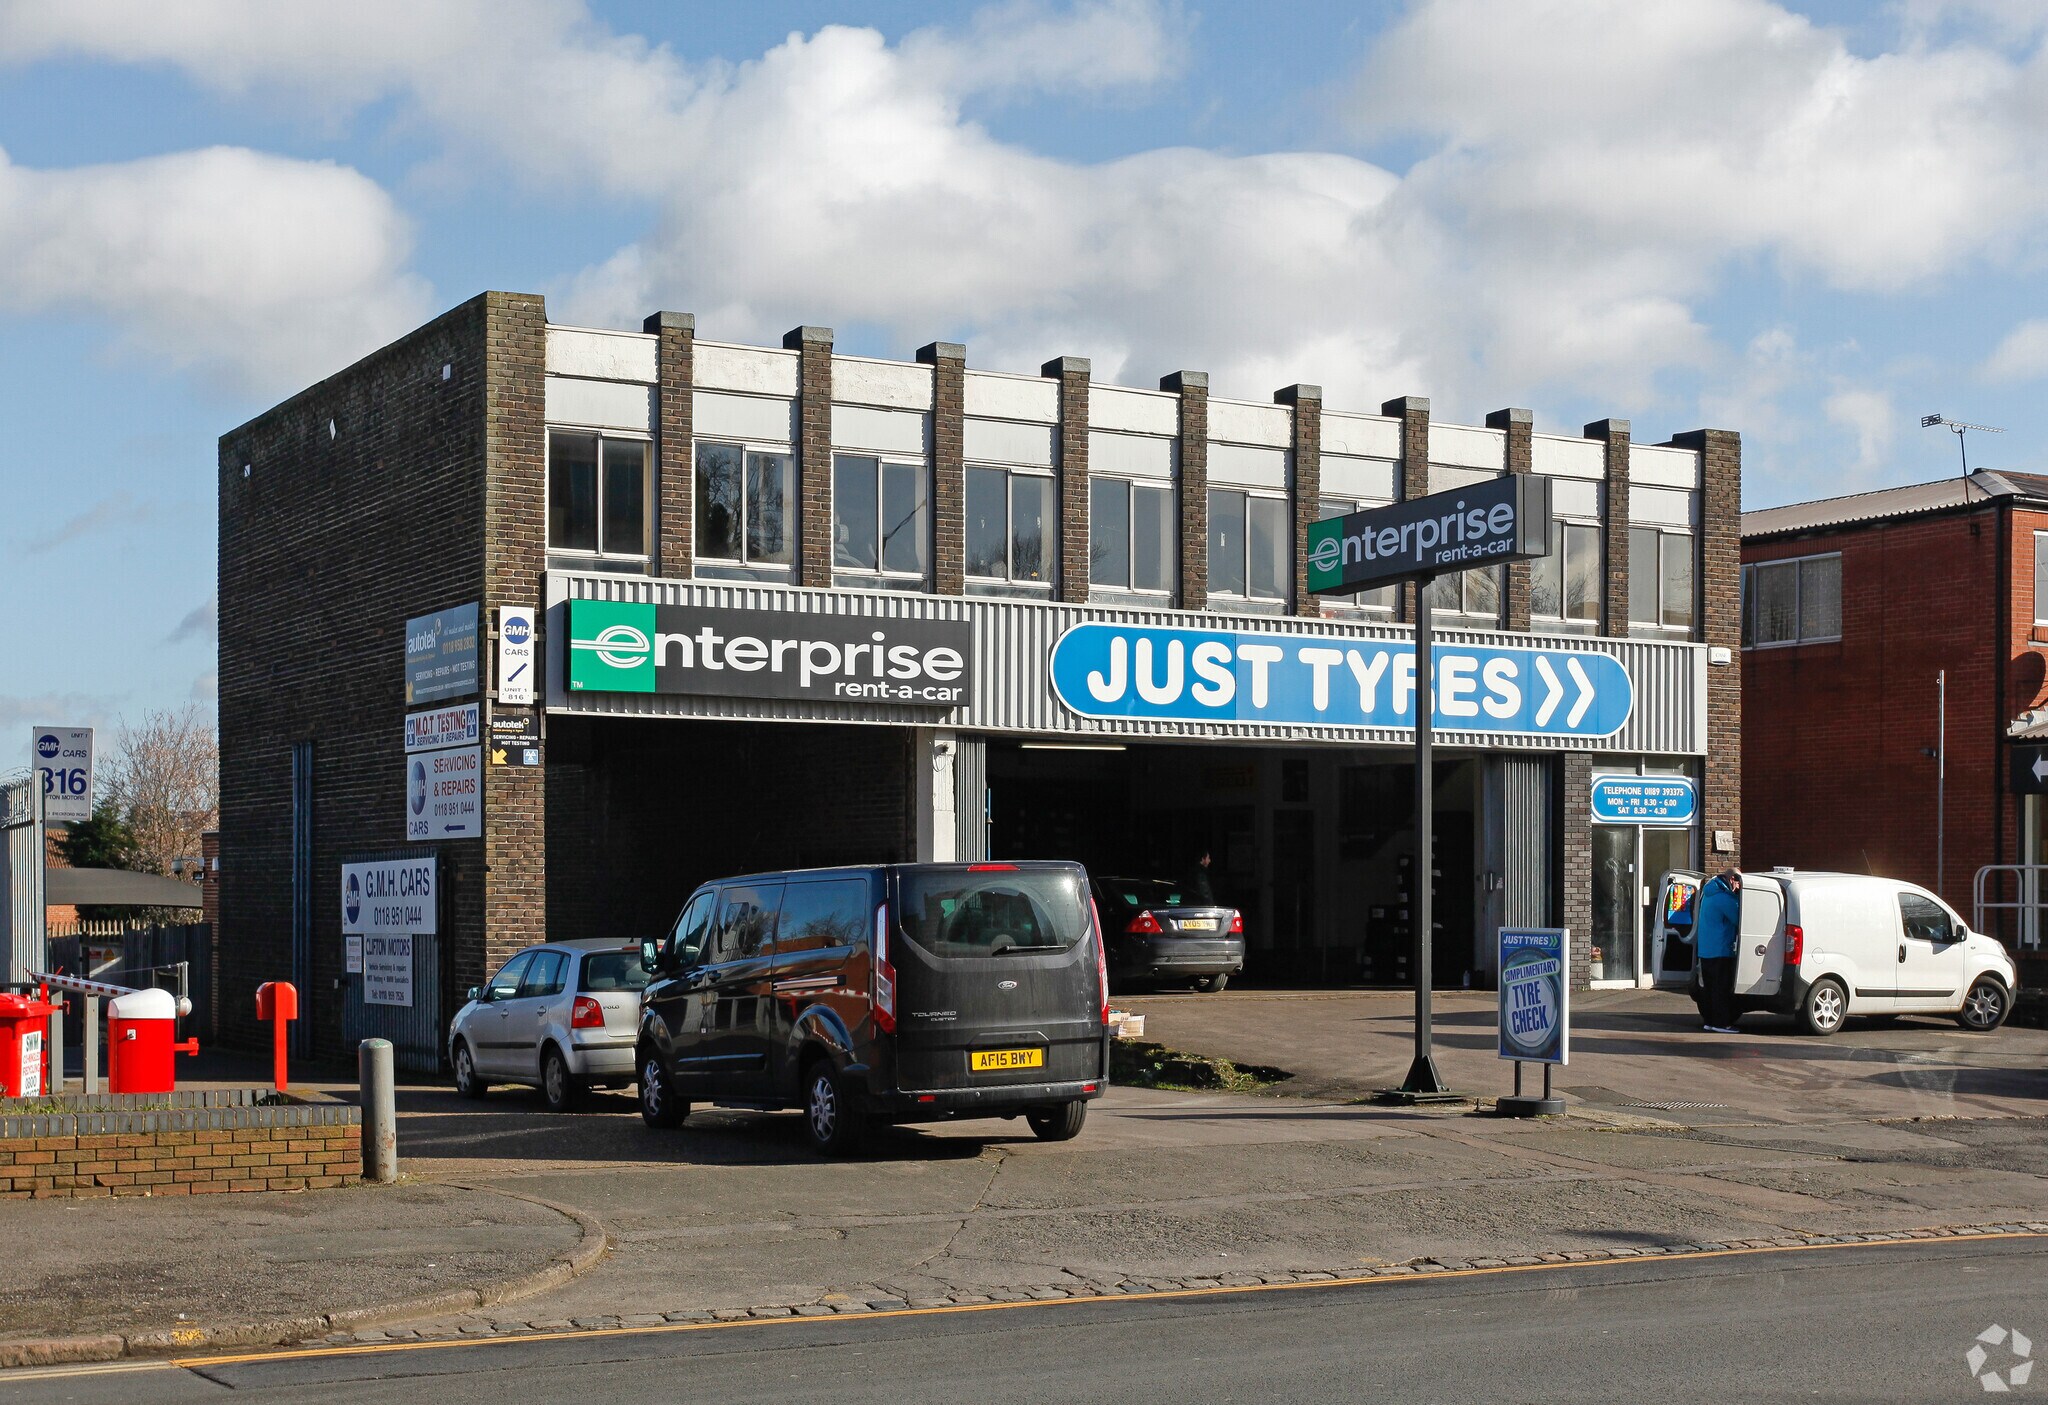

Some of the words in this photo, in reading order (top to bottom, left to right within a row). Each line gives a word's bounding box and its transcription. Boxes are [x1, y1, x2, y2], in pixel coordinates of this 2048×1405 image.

[1312, 500, 1514, 572] enterprise
[1435, 537, 1513, 564] rent-a-car
[504, 625, 531, 637] GMH
[408, 629, 436, 654] autotek
[504, 648, 529, 656] CARS
[594, 624, 964, 688] enterprise
[436, 666, 450, 676] REPAIRS
[460, 660, 476, 672] TESTING
[1086, 635, 1284, 710] JUST
[1297, 645, 1523, 720] TYRES
[834, 679, 963, 701] rent-a-car
[437, 710, 466, 734] TESTING
[492, 720, 524, 729] autotek
[37, 741, 60, 752] GMH
[416, 734, 440, 746] SERVICING
[440, 734, 444, 743] &
[446, 731, 464, 742] REPAIRS
[62, 750, 88, 758] CARS
[434, 754, 476, 774] SERVICING
[434, 782, 440, 798] &
[442, 778, 476, 797] REPAIRS
[1603, 786, 1642, 795] TELEPHONE
[1644, 787, 1660, 796] 01189
[1662, 788, 1684, 796] 393375
[434, 803, 448, 817] 0118
[448, 802, 459, 816] 951
[461, 801, 474, 815] 0444
[408, 821, 429, 835] CARS
[366, 869, 398, 898] G.M.H.
[400, 867, 430, 897] CARS
[374, 907, 390, 926] 0118
[392, 907, 404, 925] 951
[406, 906, 422, 926] 0444
[366, 938, 386, 956] CLIFTON
[388, 938, 410, 956] MOTORS
[1503, 936, 1523, 946] JUST
[1524, 936, 1549, 946] TYRES
[1504, 960, 1557, 983] COMPLIMENTARY
[1512, 980, 1542, 1009] TYRE
[912, 1010, 958, 1018] TOURNEO
[1512, 1004, 1549, 1035] CHECK
[26, 1033, 39, 1052] SWM
[980, 1054, 1008, 1067] AF15
[1010, 1052, 1033, 1065] BWY
